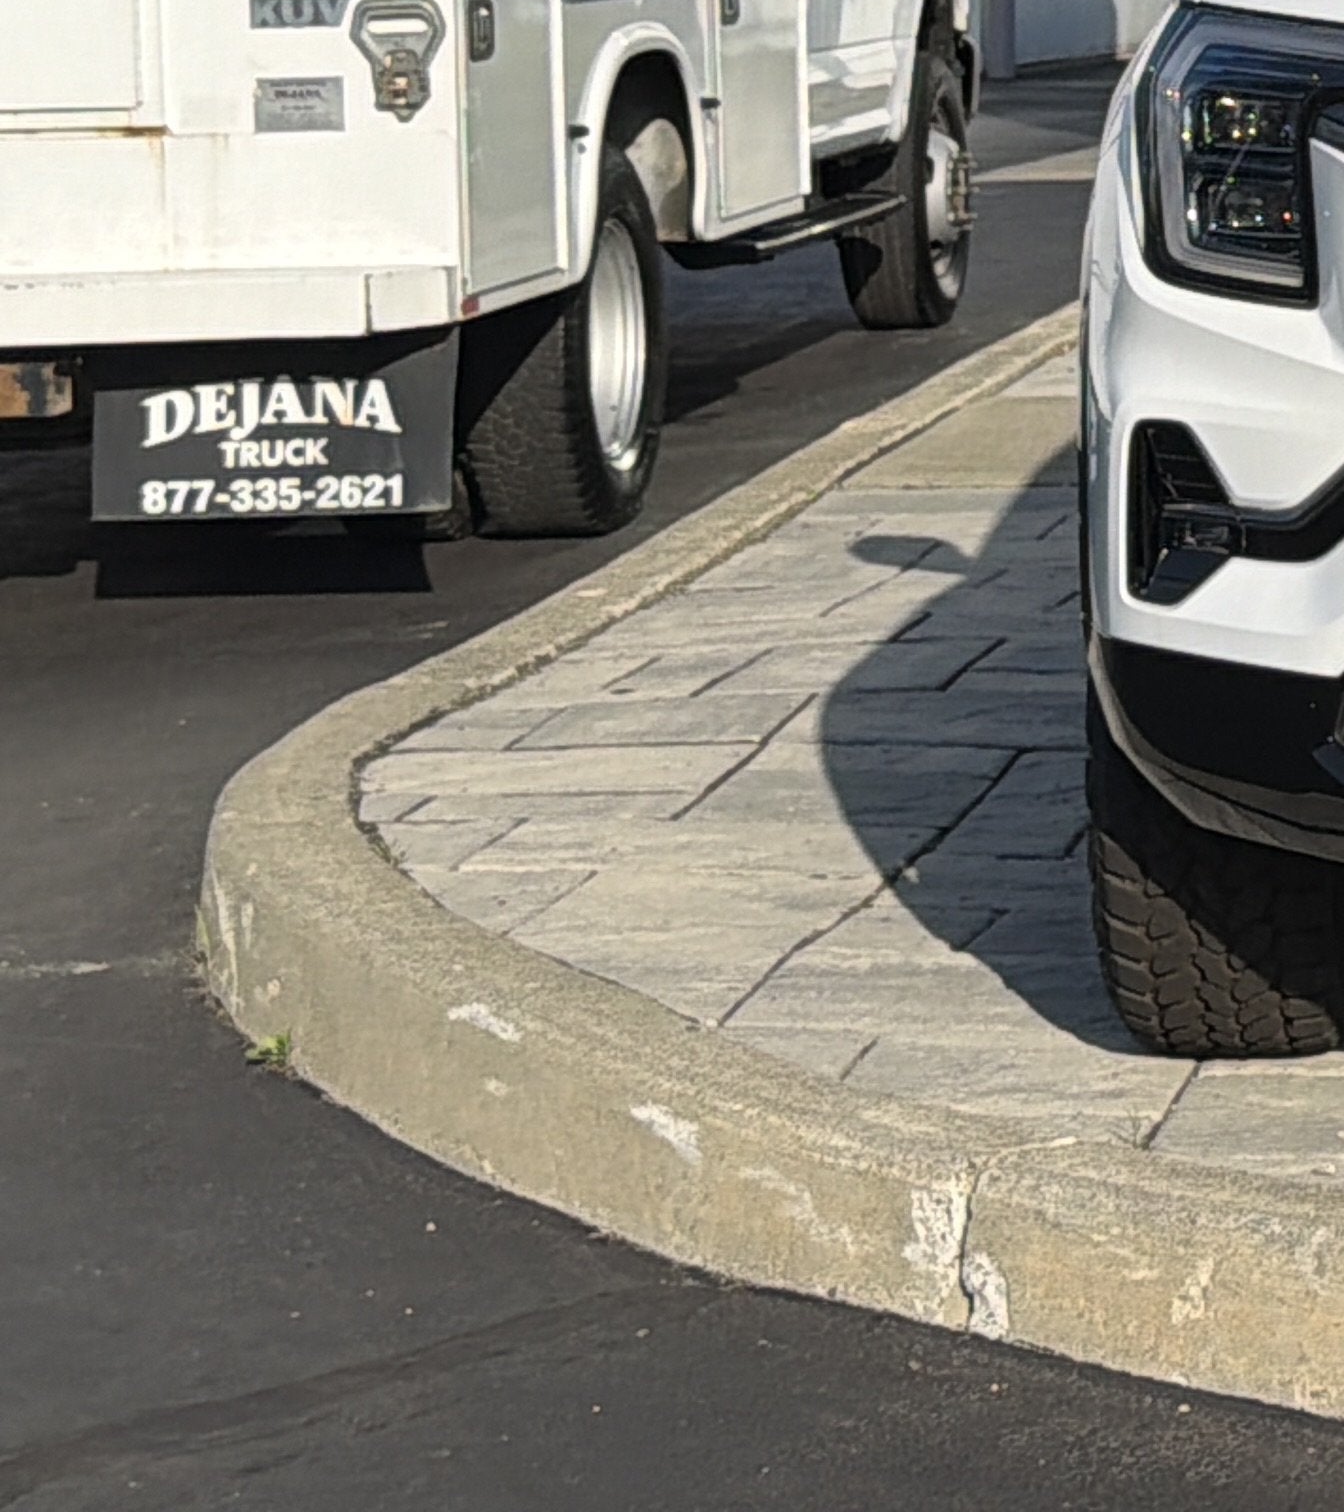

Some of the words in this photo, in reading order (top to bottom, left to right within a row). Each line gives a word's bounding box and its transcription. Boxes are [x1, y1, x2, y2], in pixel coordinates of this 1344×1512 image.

[140, 374, 402, 448] DEJANA
[218, 438, 329, 468] TRUCK
[141, 474, 403, 514] 877-335-2621
